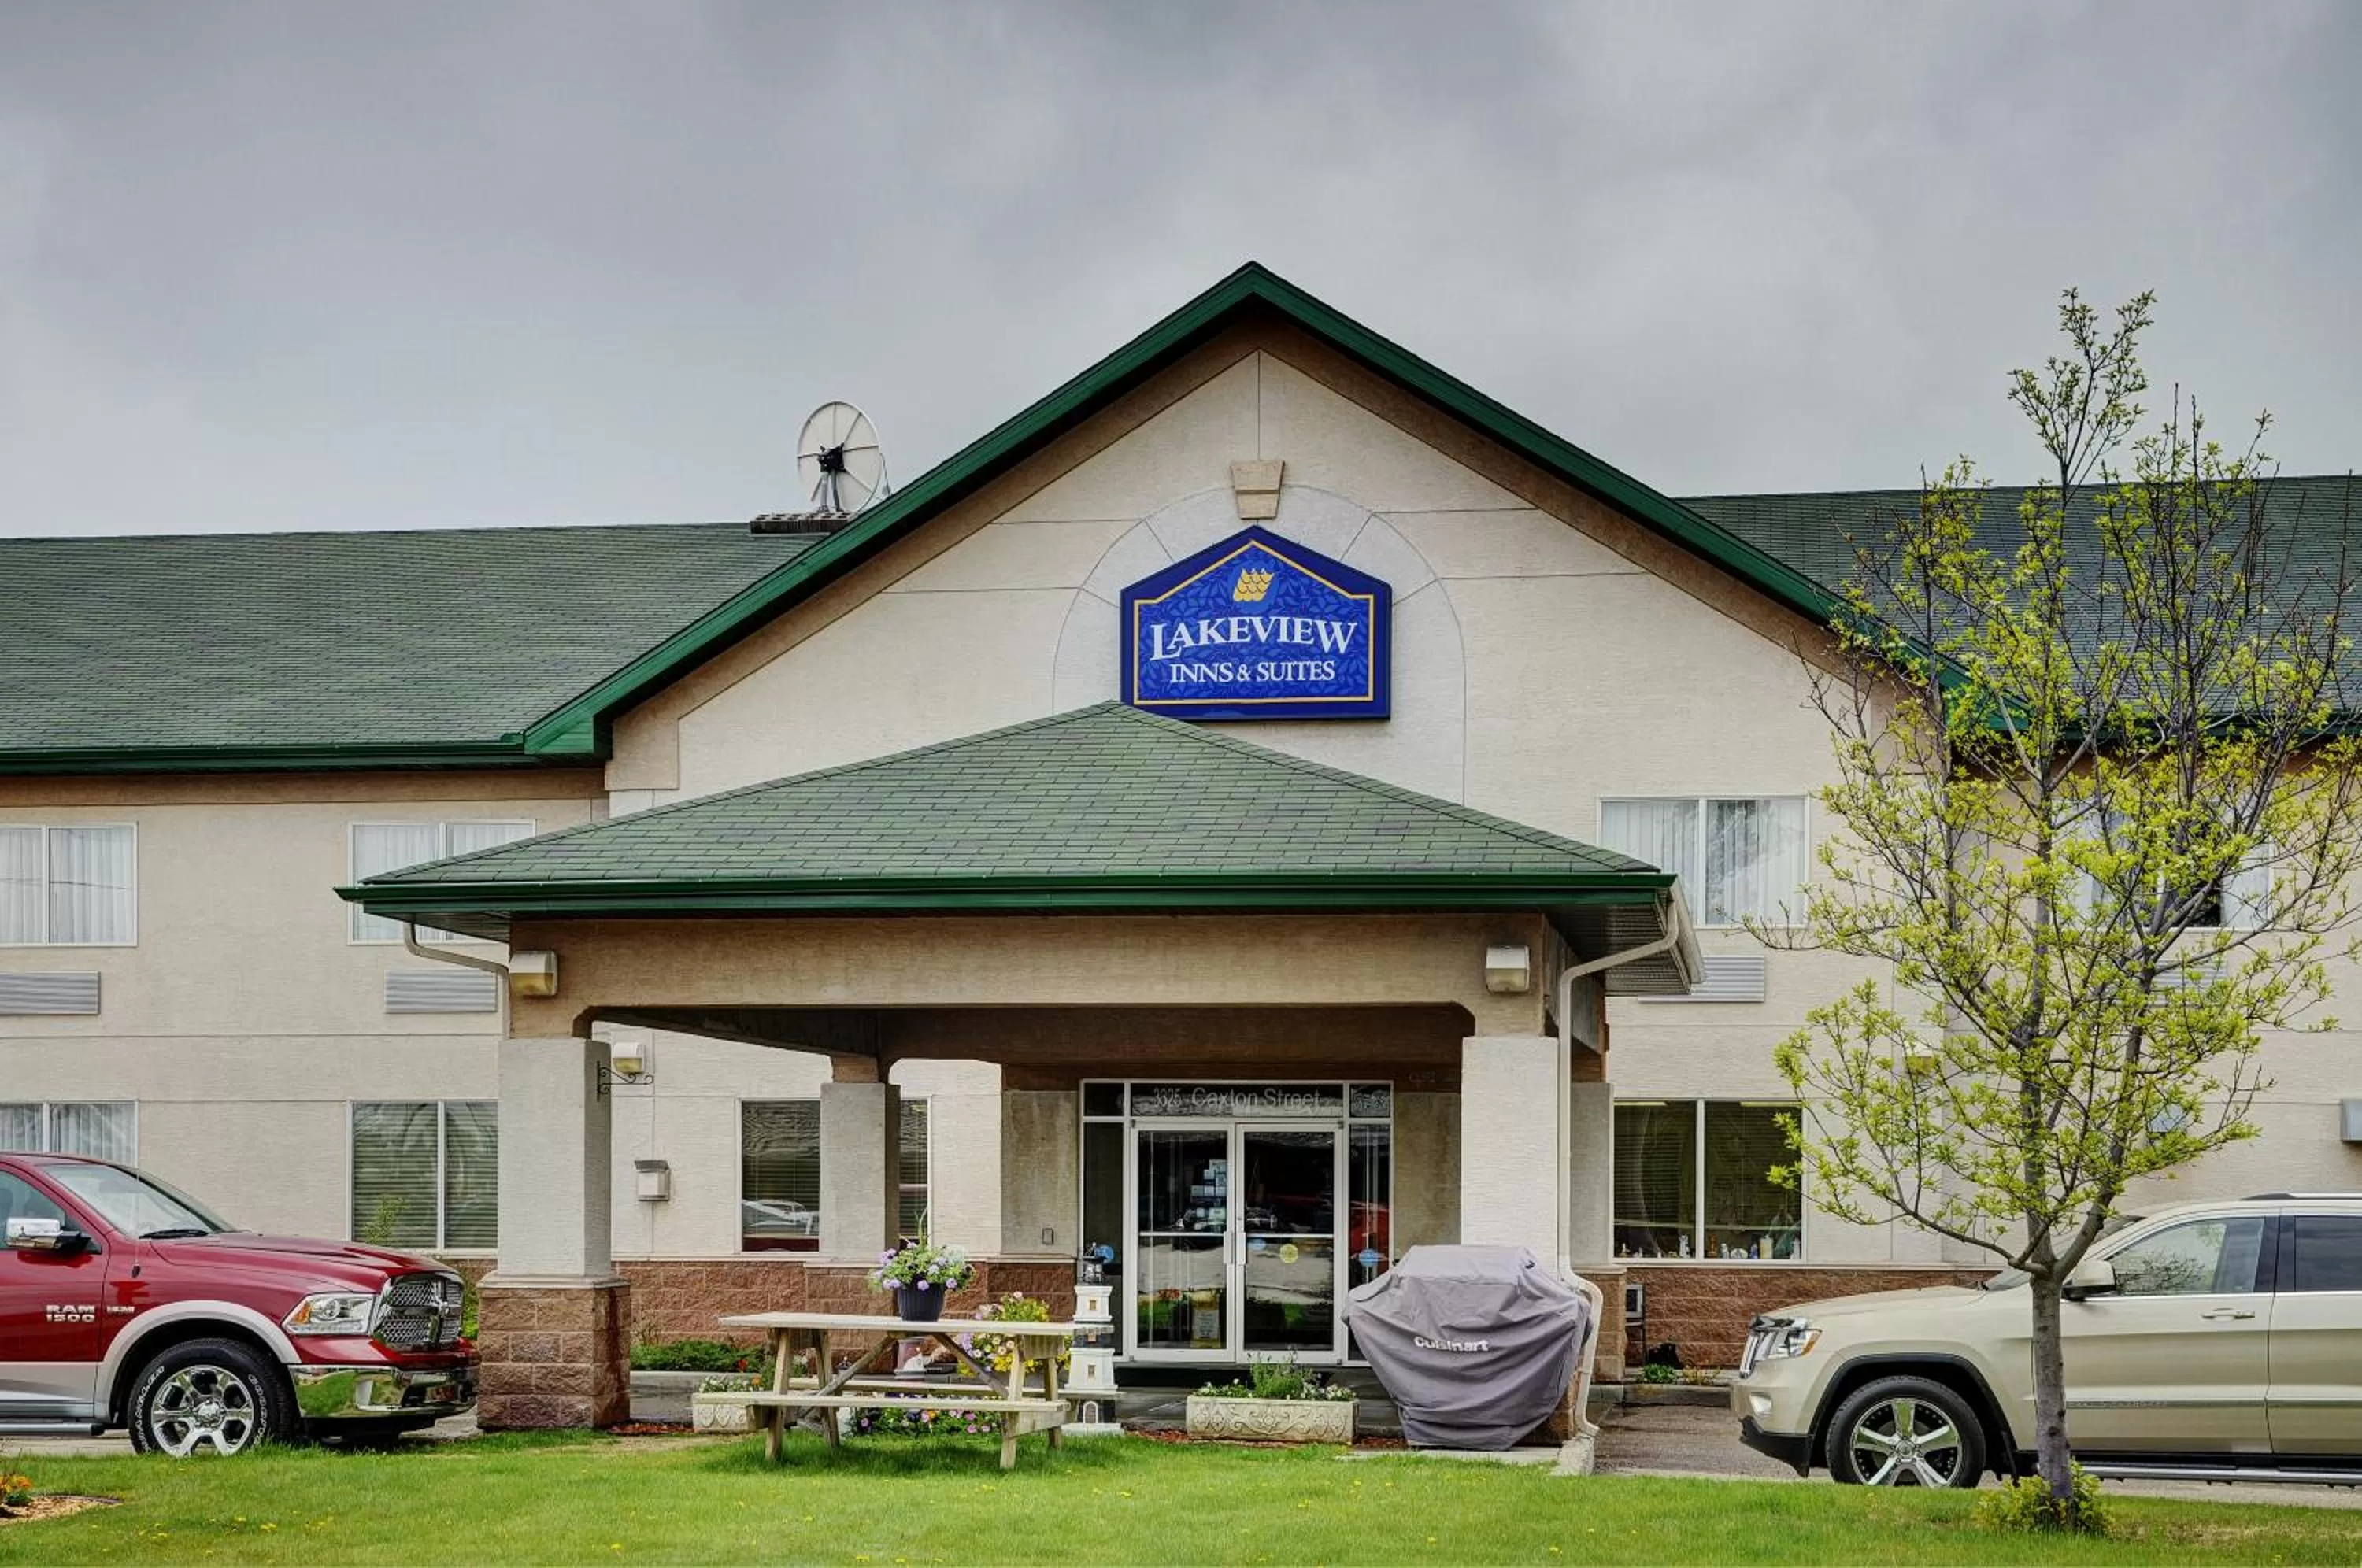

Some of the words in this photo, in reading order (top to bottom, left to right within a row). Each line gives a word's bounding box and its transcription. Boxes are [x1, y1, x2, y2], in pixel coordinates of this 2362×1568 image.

[1150, 616, 1358, 661] LAKEVIEW
[1169, 663, 1234, 683] INNS
[1237, 667, 1251, 682] &
[1256, 660, 1335, 682] SUITES
[1191, 1087, 1257, 1108] Caxton
[1264, 1088, 1320, 1108] Street
[46, 1304, 95, 1314] RAM
[46, 1314, 95, 1322] 1500
